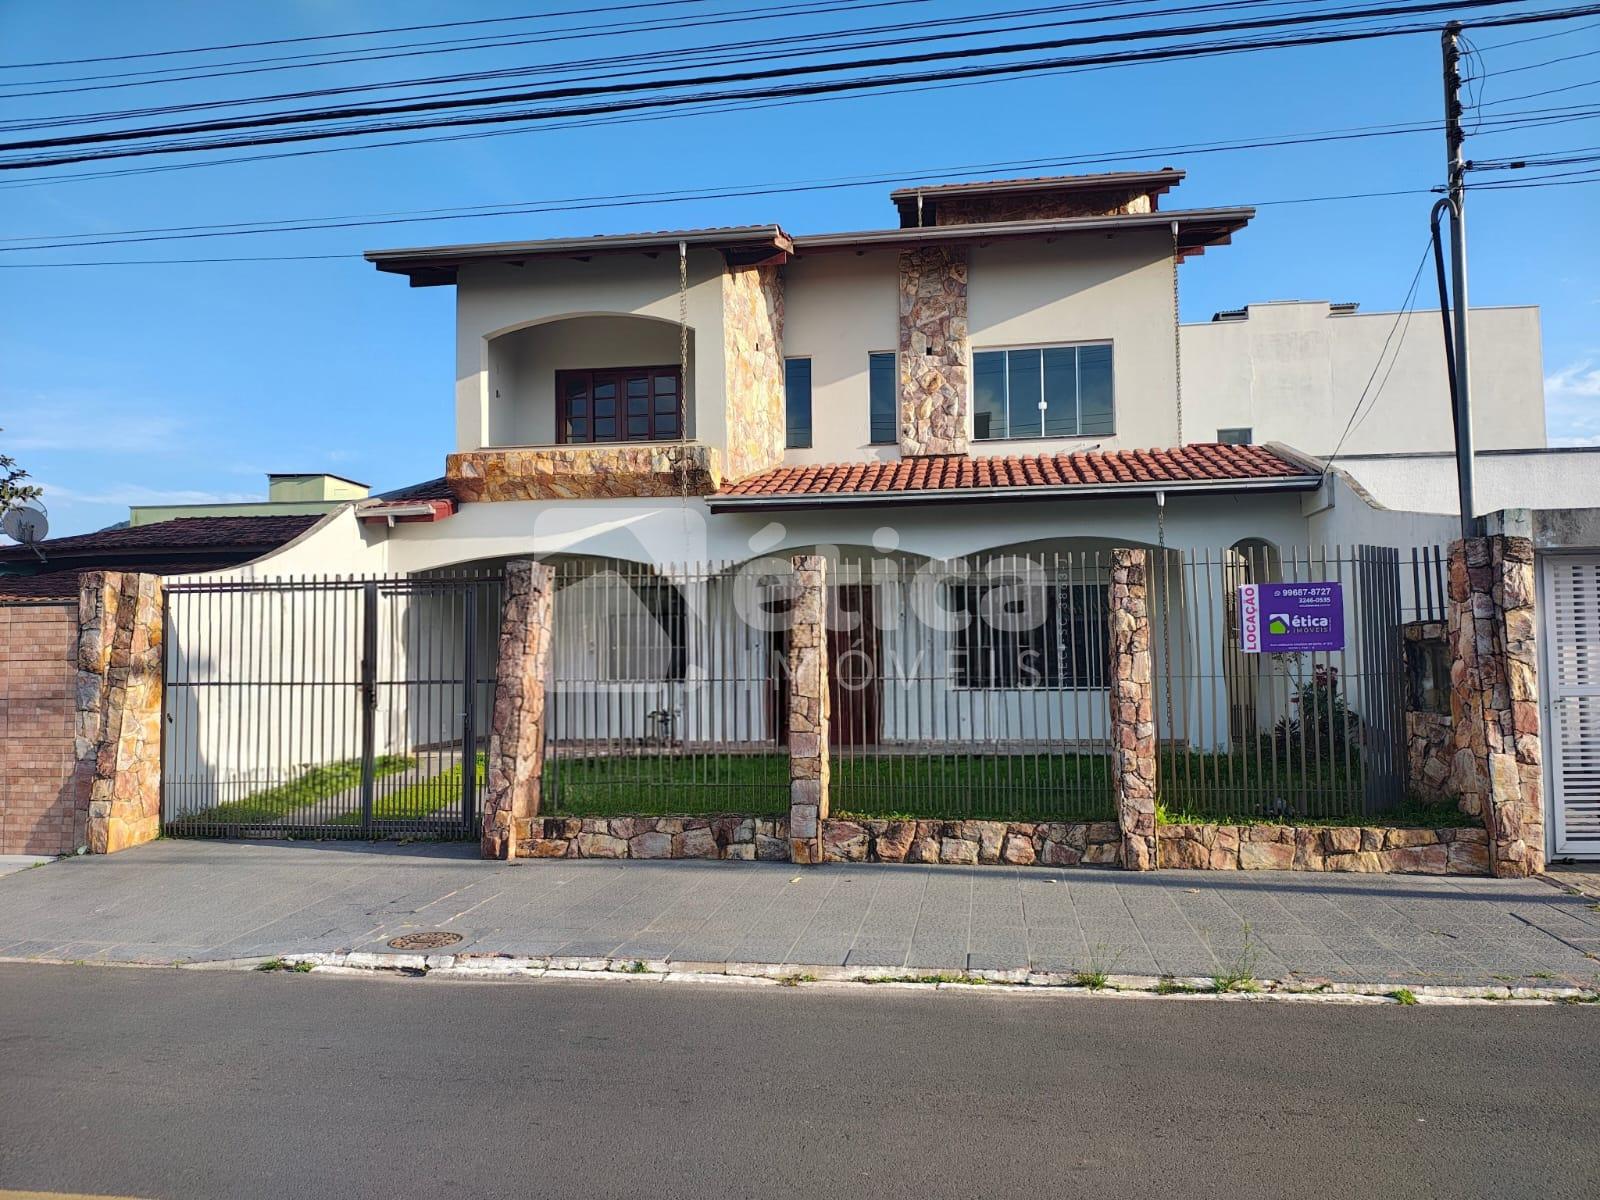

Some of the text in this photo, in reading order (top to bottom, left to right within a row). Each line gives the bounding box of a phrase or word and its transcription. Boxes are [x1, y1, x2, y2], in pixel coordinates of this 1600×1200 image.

[1282, 587, 1331, 597] 99687-8727
[1244, 587, 1257, 651] LOCAÇÃO
[1291, 614, 1328, 627] ética
